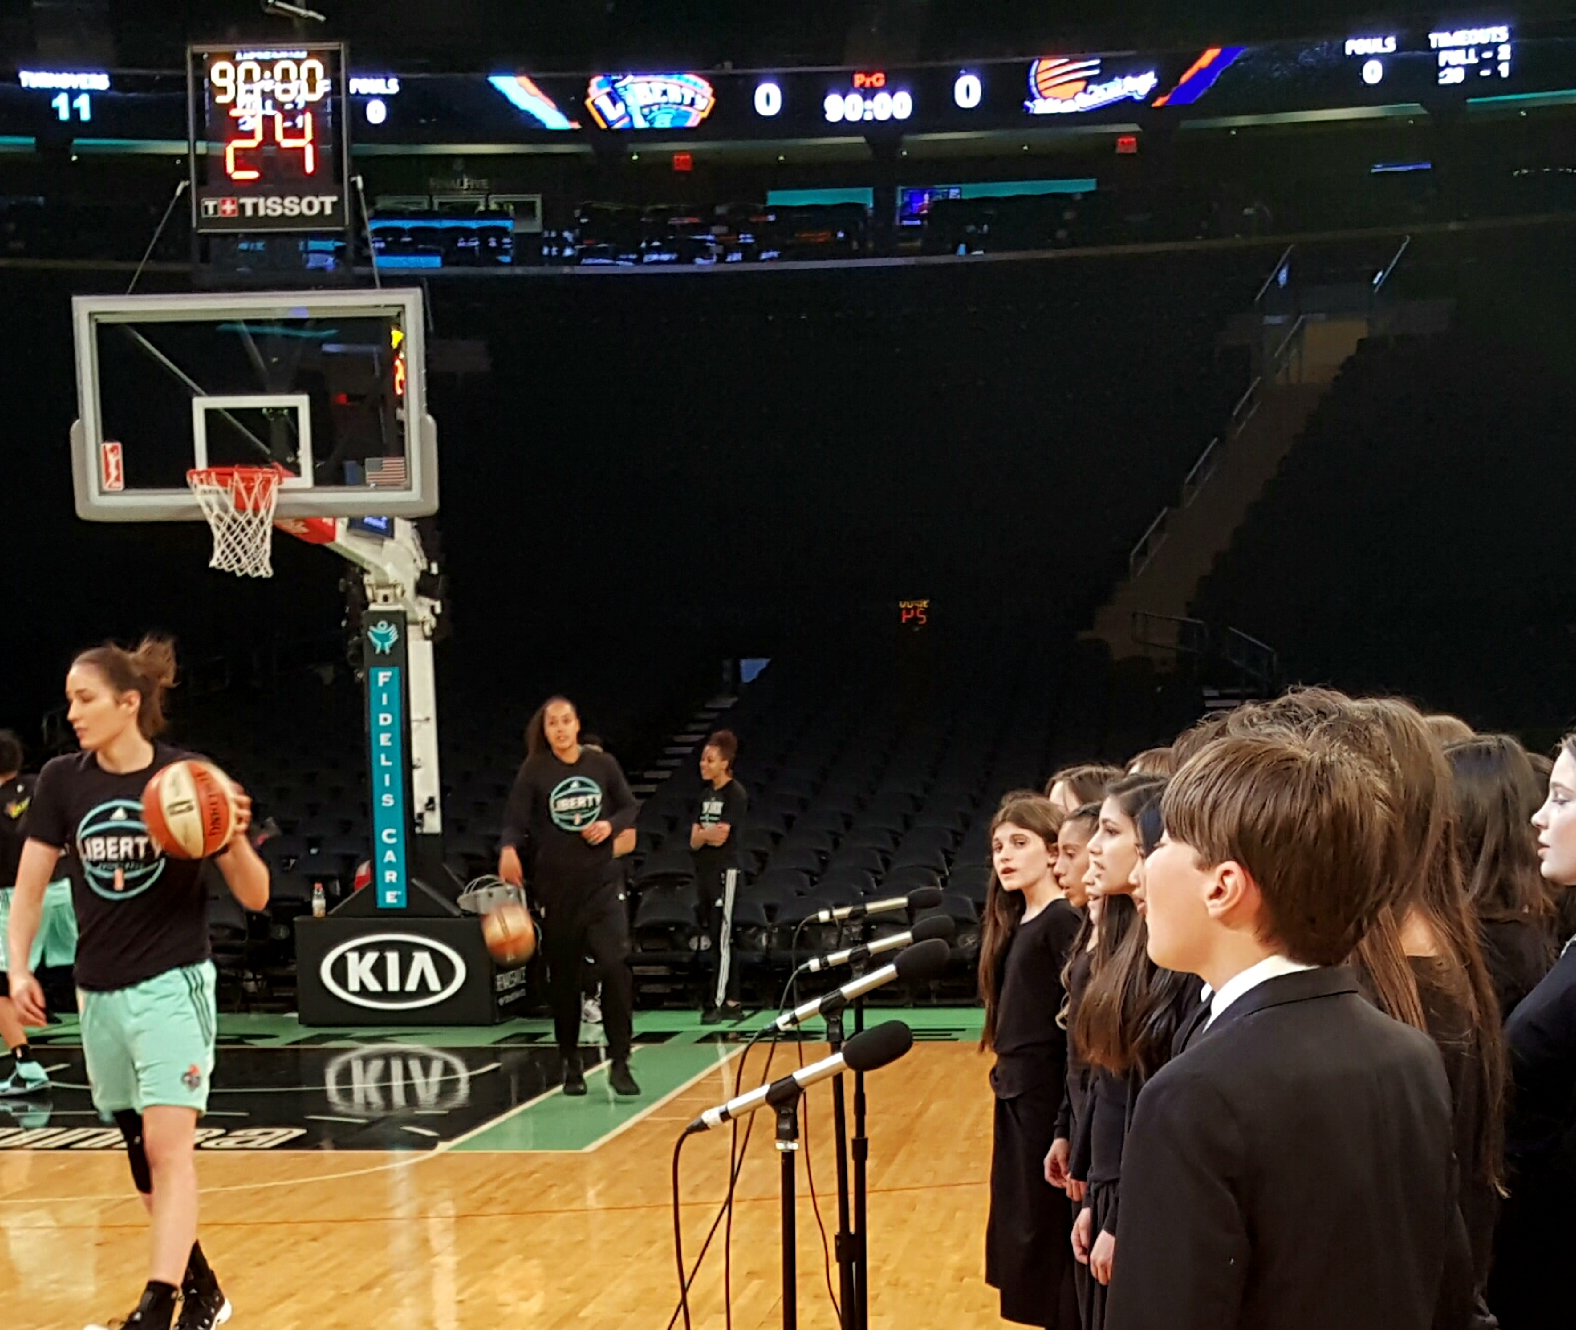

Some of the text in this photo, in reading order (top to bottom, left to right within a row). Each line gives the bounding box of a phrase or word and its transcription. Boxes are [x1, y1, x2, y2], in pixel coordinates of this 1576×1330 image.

[1345, 36, 1397, 55] FOULS
[1428, 25, 1509, 49] TIMEOUTS
[1362, 60, 1383, 84] 0
[1438, 47, 1479, 67] FULL
[210, 59, 325, 104] 90:00
[954, 74, 982, 108] 0
[51, 92, 91, 121] 11
[366, 99, 387, 125] 0
[754, 83, 782, 116] 0
[823, 91, 913, 122] 90:00
[225, 111, 314, 181] 24
[239, 195, 339, 217] TISSOT
[377, 671, 399, 904] FIDELIS CARE
[345, 951, 443, 992] KIA
